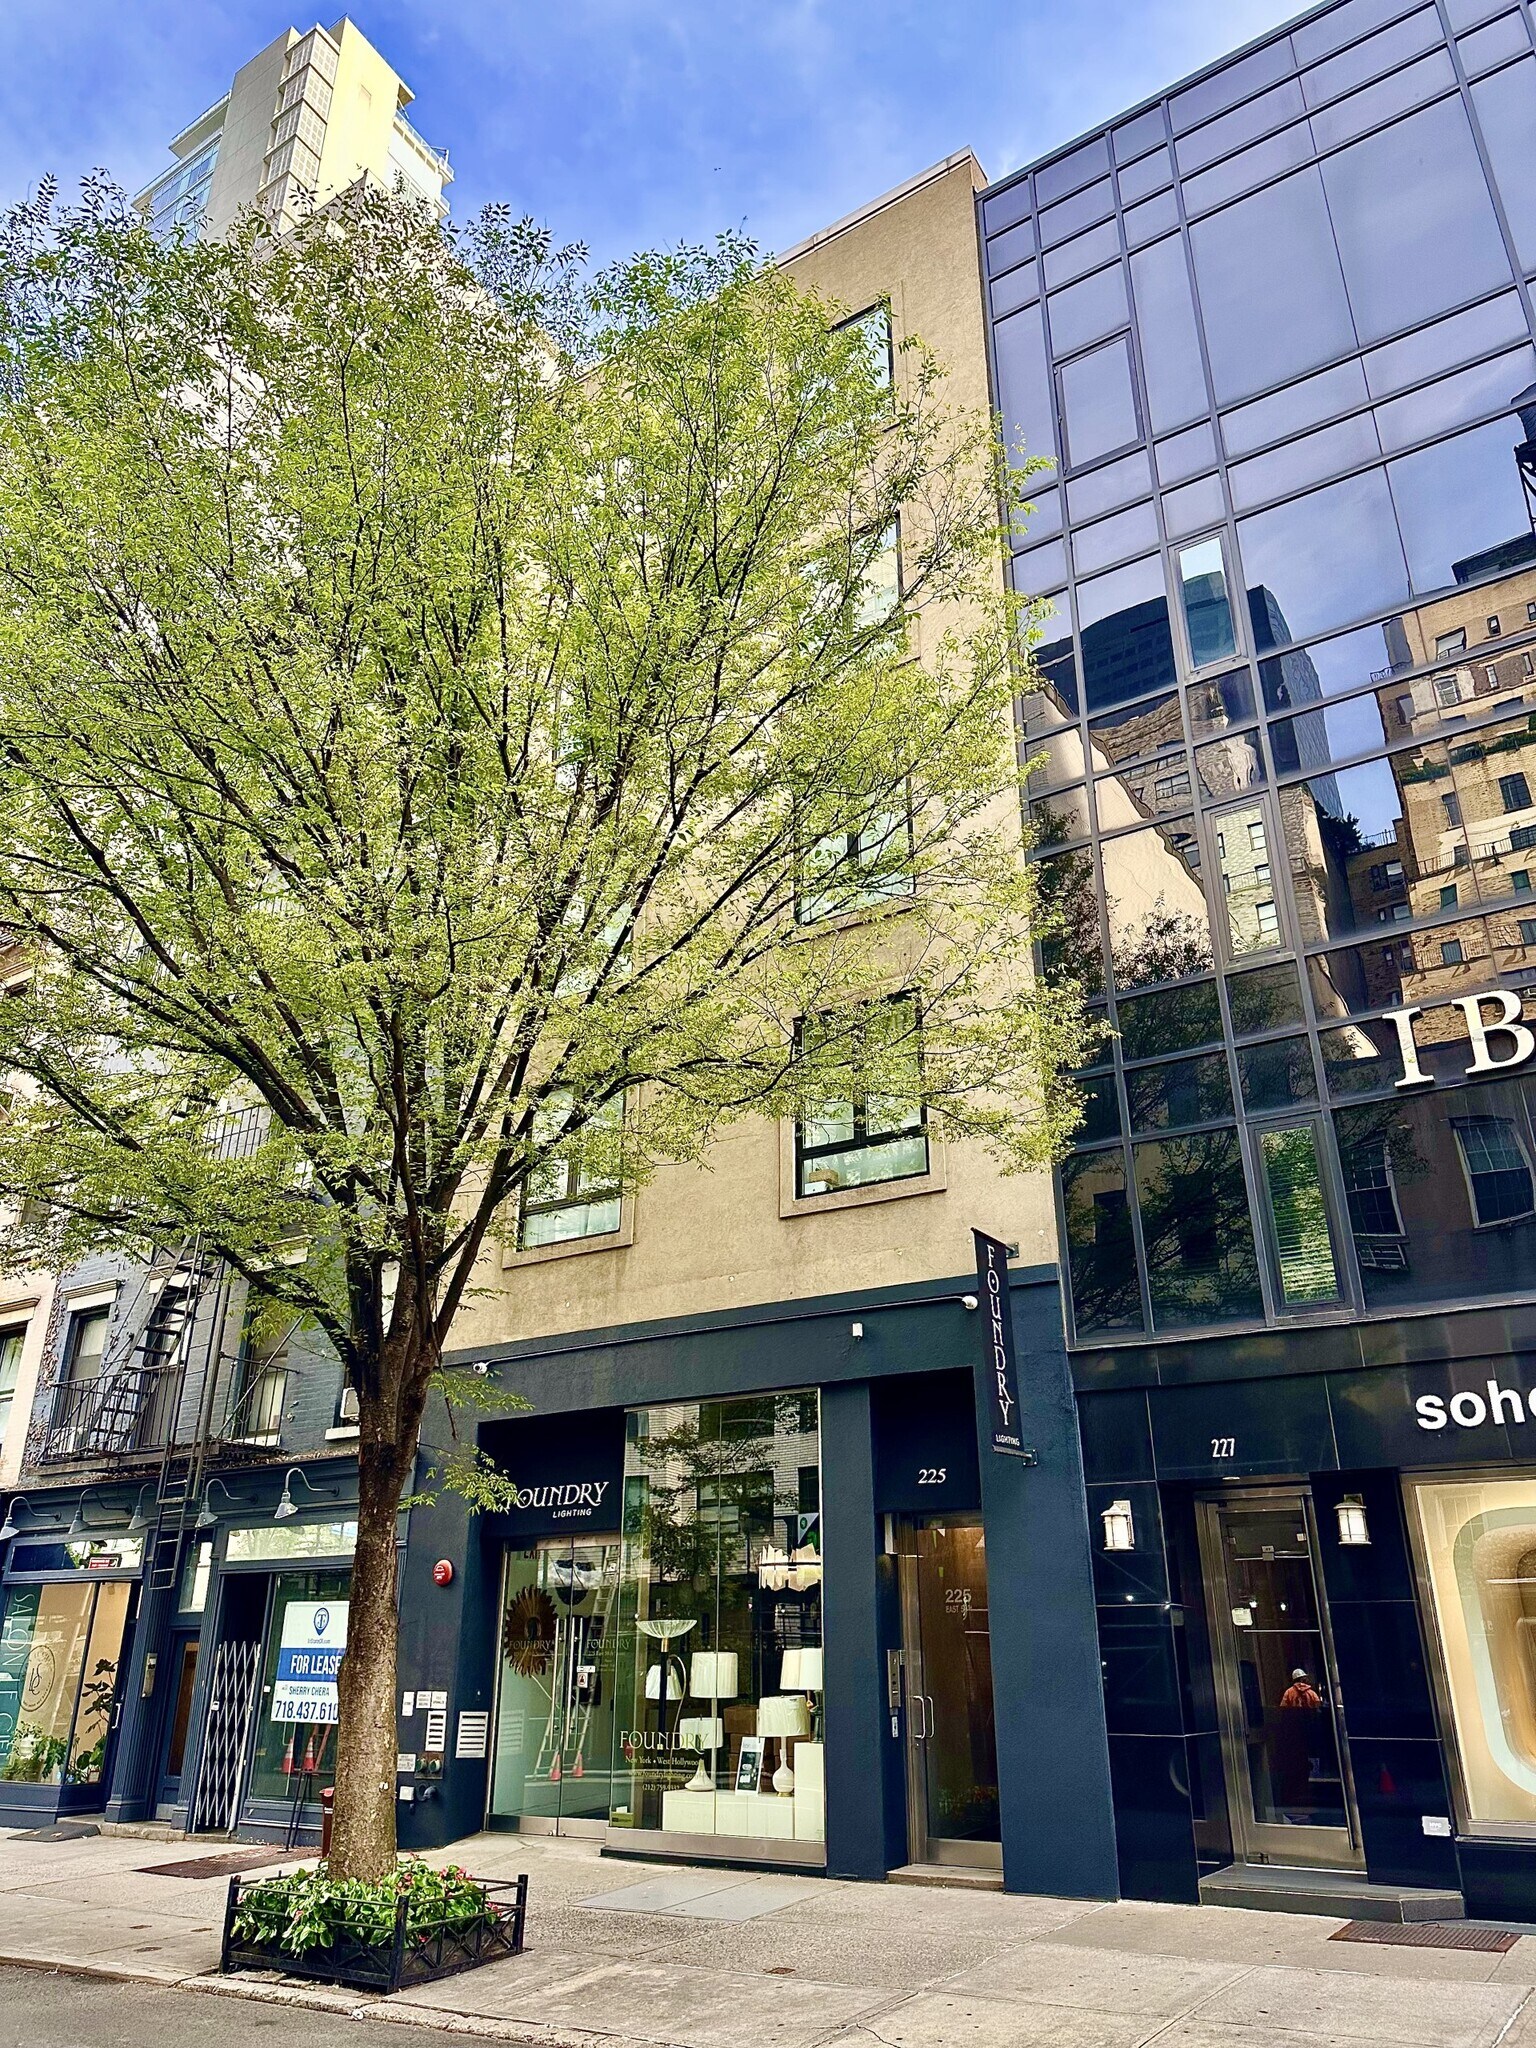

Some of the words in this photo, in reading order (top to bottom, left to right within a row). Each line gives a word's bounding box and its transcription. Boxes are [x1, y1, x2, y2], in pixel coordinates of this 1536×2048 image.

[986, 1243, 1014, 1426] FOUNDRY
[1415, 1379, 1536, 1430] soh
[995, 1433, 1020, 1446] LIGHTING
[1210, 1437, 1235, 1458] 227
[917, 1468, 947, 1484] 225
[552, 1508, 592, 1519] LIGHTING
[945, 1588, 972, 1603] 225
[586, 1638, 631, 1650] FOUNDRY
[290, 1654, 309, 1675] FOR
[310, 1655, 342, 1676] LEASE
[288, 1685, 310, 1696] SHERRY
[311, 1686, 330, 1697] CHERA
[619, 1730, 710, 1755] FOUNDRY
[639, 1755, 652, 1764] York
[672, 1757, 701, 1768] Hollywoo
